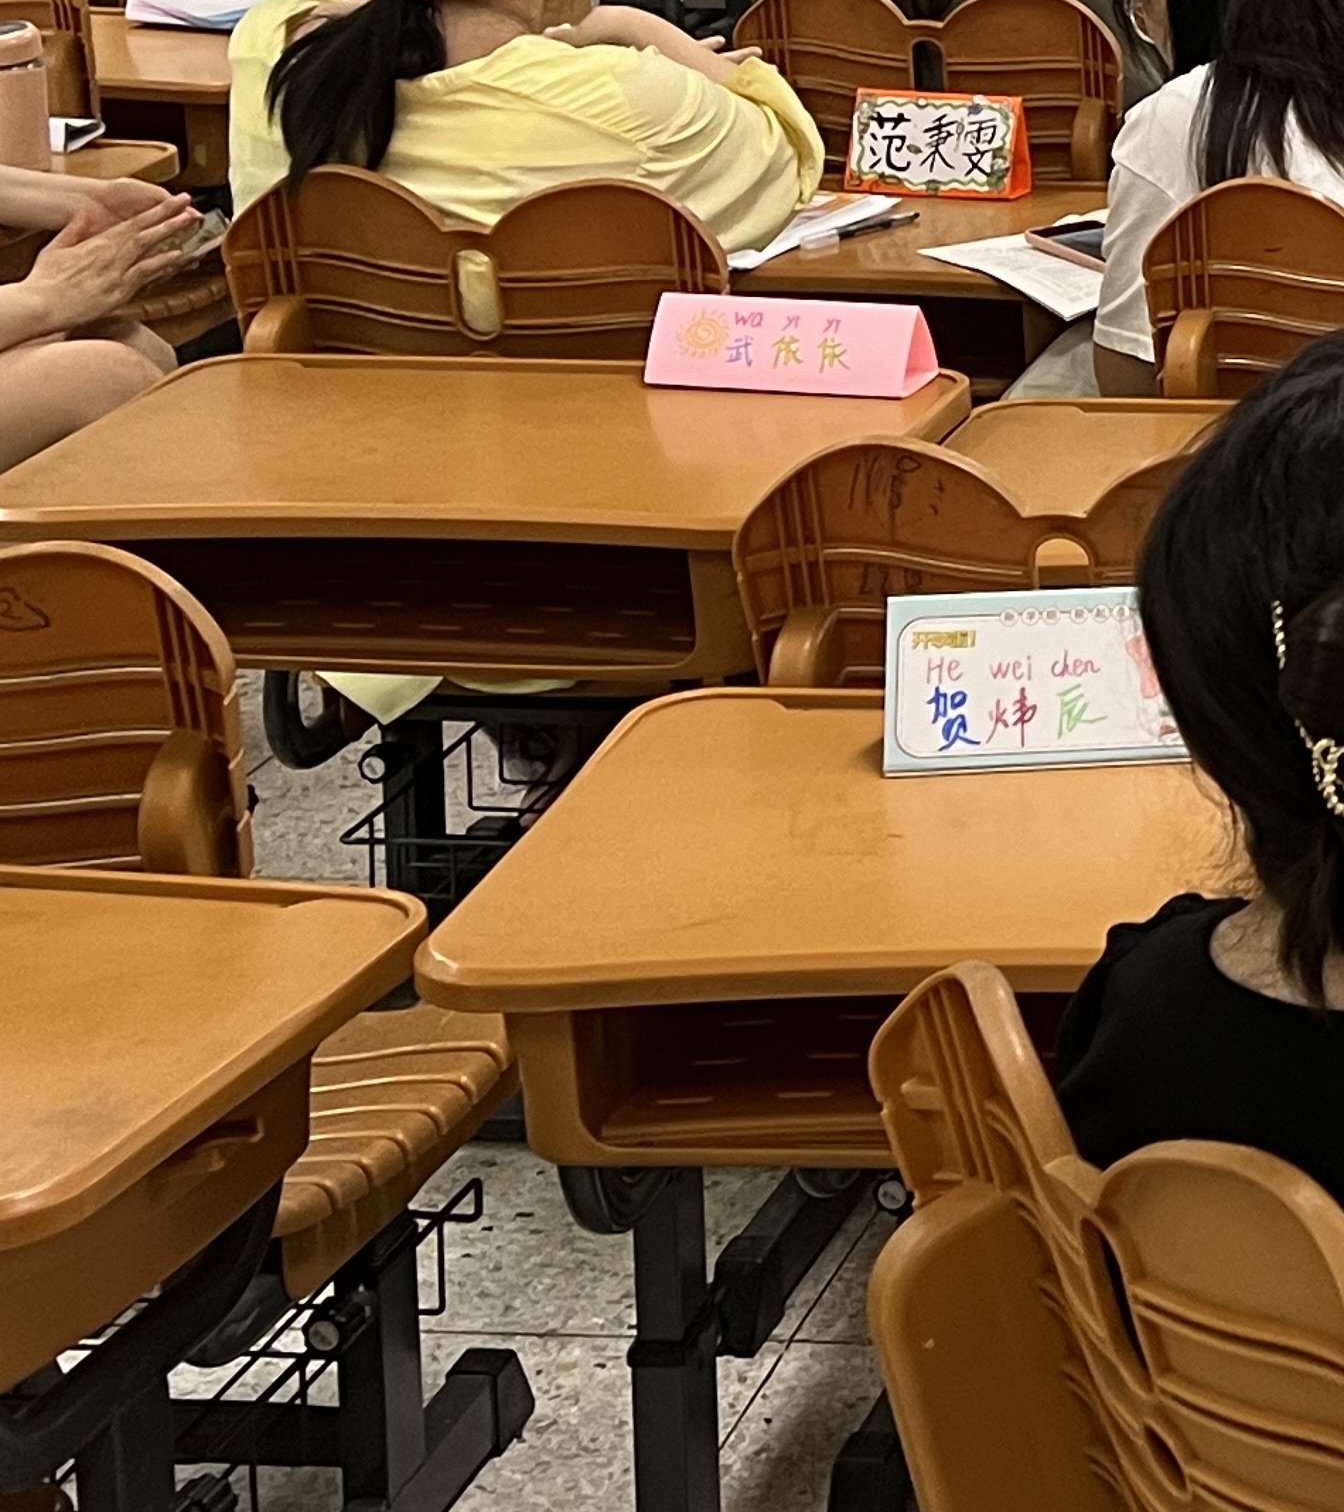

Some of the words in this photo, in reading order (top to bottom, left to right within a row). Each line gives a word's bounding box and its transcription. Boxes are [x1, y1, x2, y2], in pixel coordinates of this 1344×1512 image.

[868, 111, 999, 178] 范秉雯
[926, 656, 964, 684] He
[990, 655, 1033, 682] wei
